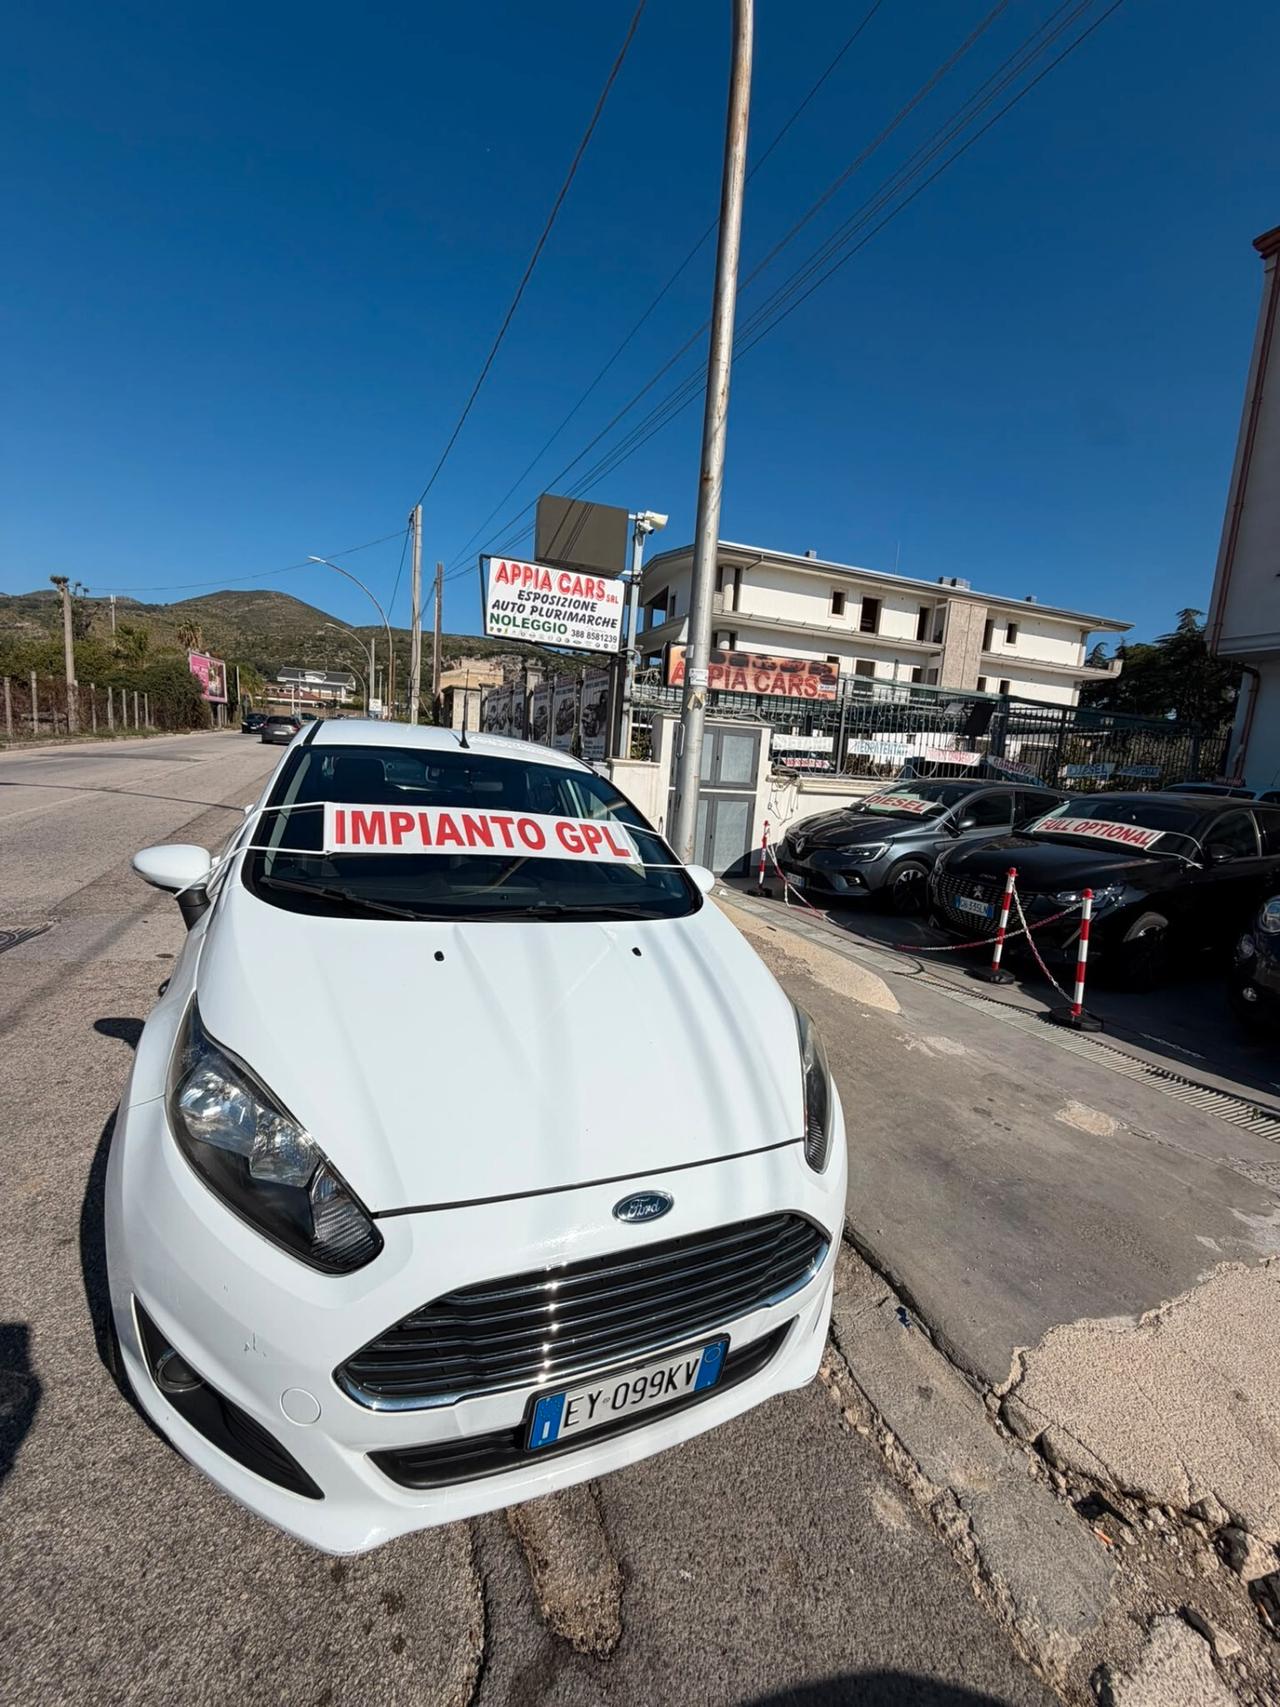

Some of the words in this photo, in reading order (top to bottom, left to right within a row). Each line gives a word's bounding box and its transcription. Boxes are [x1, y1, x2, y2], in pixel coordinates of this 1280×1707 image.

[495, 561, 552, 592] APPIA
[558, 573, 606, 601] CARS
[606, 594, 619, 604] SRL
[492, 599, 525, 614] AUTO
[529, 606, 618, 629] PLURIMARCHE
[517, 590, 598, 613] ESPOSIZIONE
[489, 613, 568, 635] NOLEGGIO
[571, 629, 585, 639] 388
[586, 631, 618, 644] 8581239
[671, 661, 748, 690] APIA
[753, 671, 818, 697] CARS
[865, 795, 926, 812] DIESEL
[335, 810, 546, 850] IMPIANTO
[555, 821, 631, 857] GPL
[1038, 819, 1073, 831] FULL
[1073, 821, 1155, 846] OPTIONAL
[627, 1199, 660, 1219] Ford
